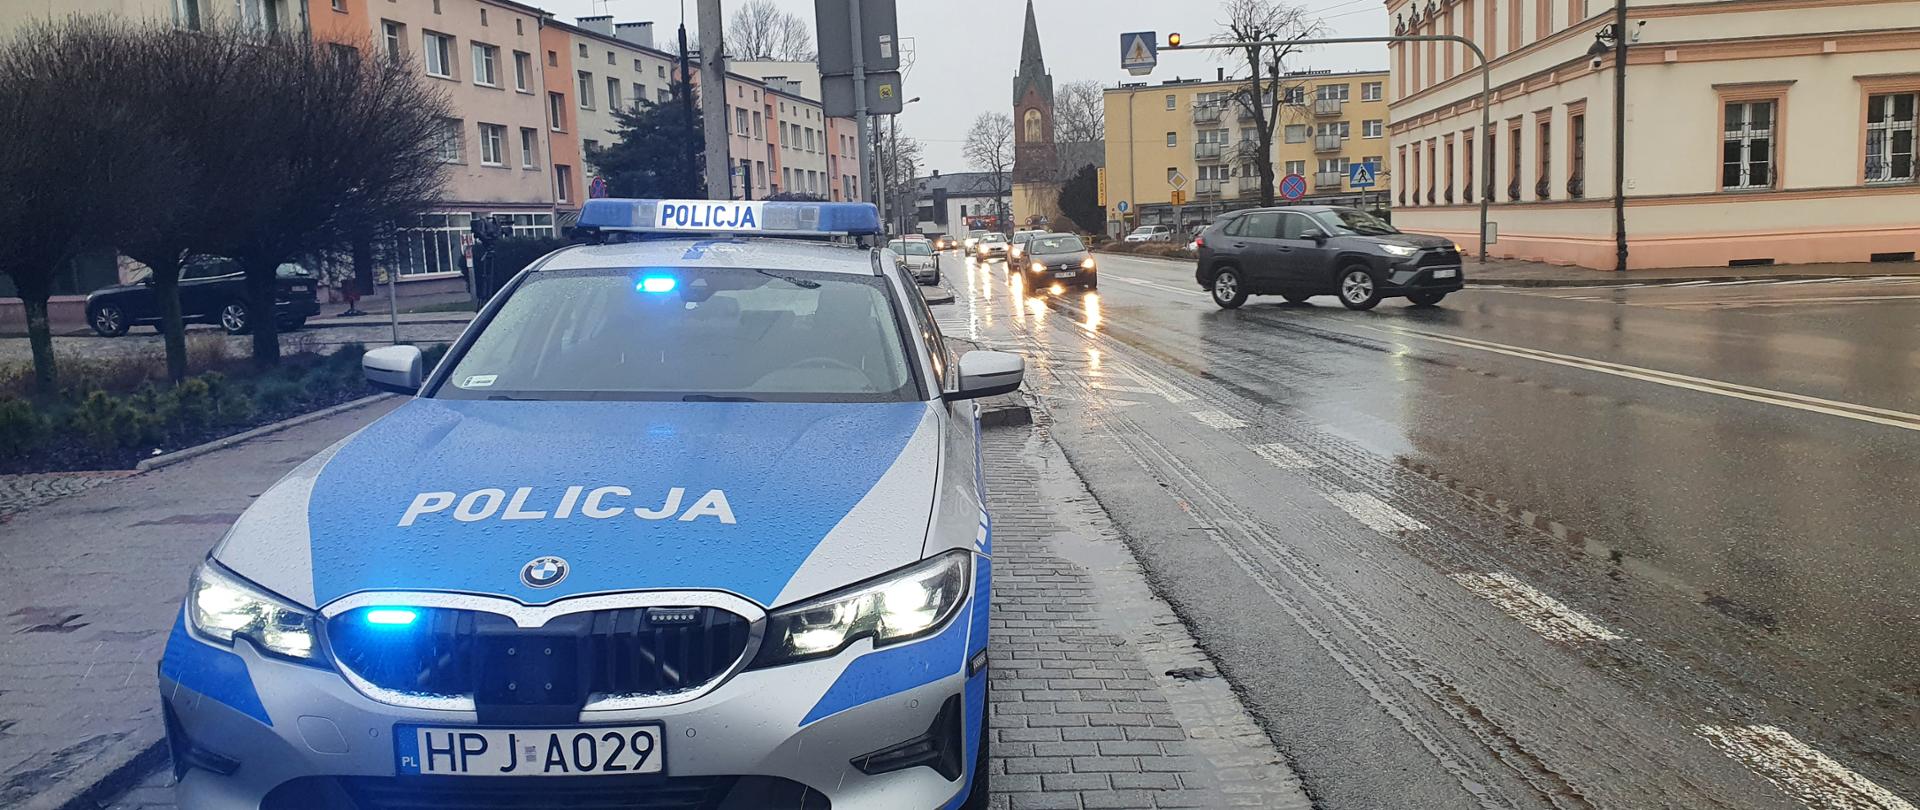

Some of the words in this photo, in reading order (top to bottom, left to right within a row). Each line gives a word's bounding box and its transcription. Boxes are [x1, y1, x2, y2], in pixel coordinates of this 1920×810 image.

[661, 204, 756, 228] POLICJA
[397, 485, 737, 525] POLICJA
[401, 756, 418, 767] PL
[425, 731, 518, 773] HPJ
[543, 730, 655, 773] A029
